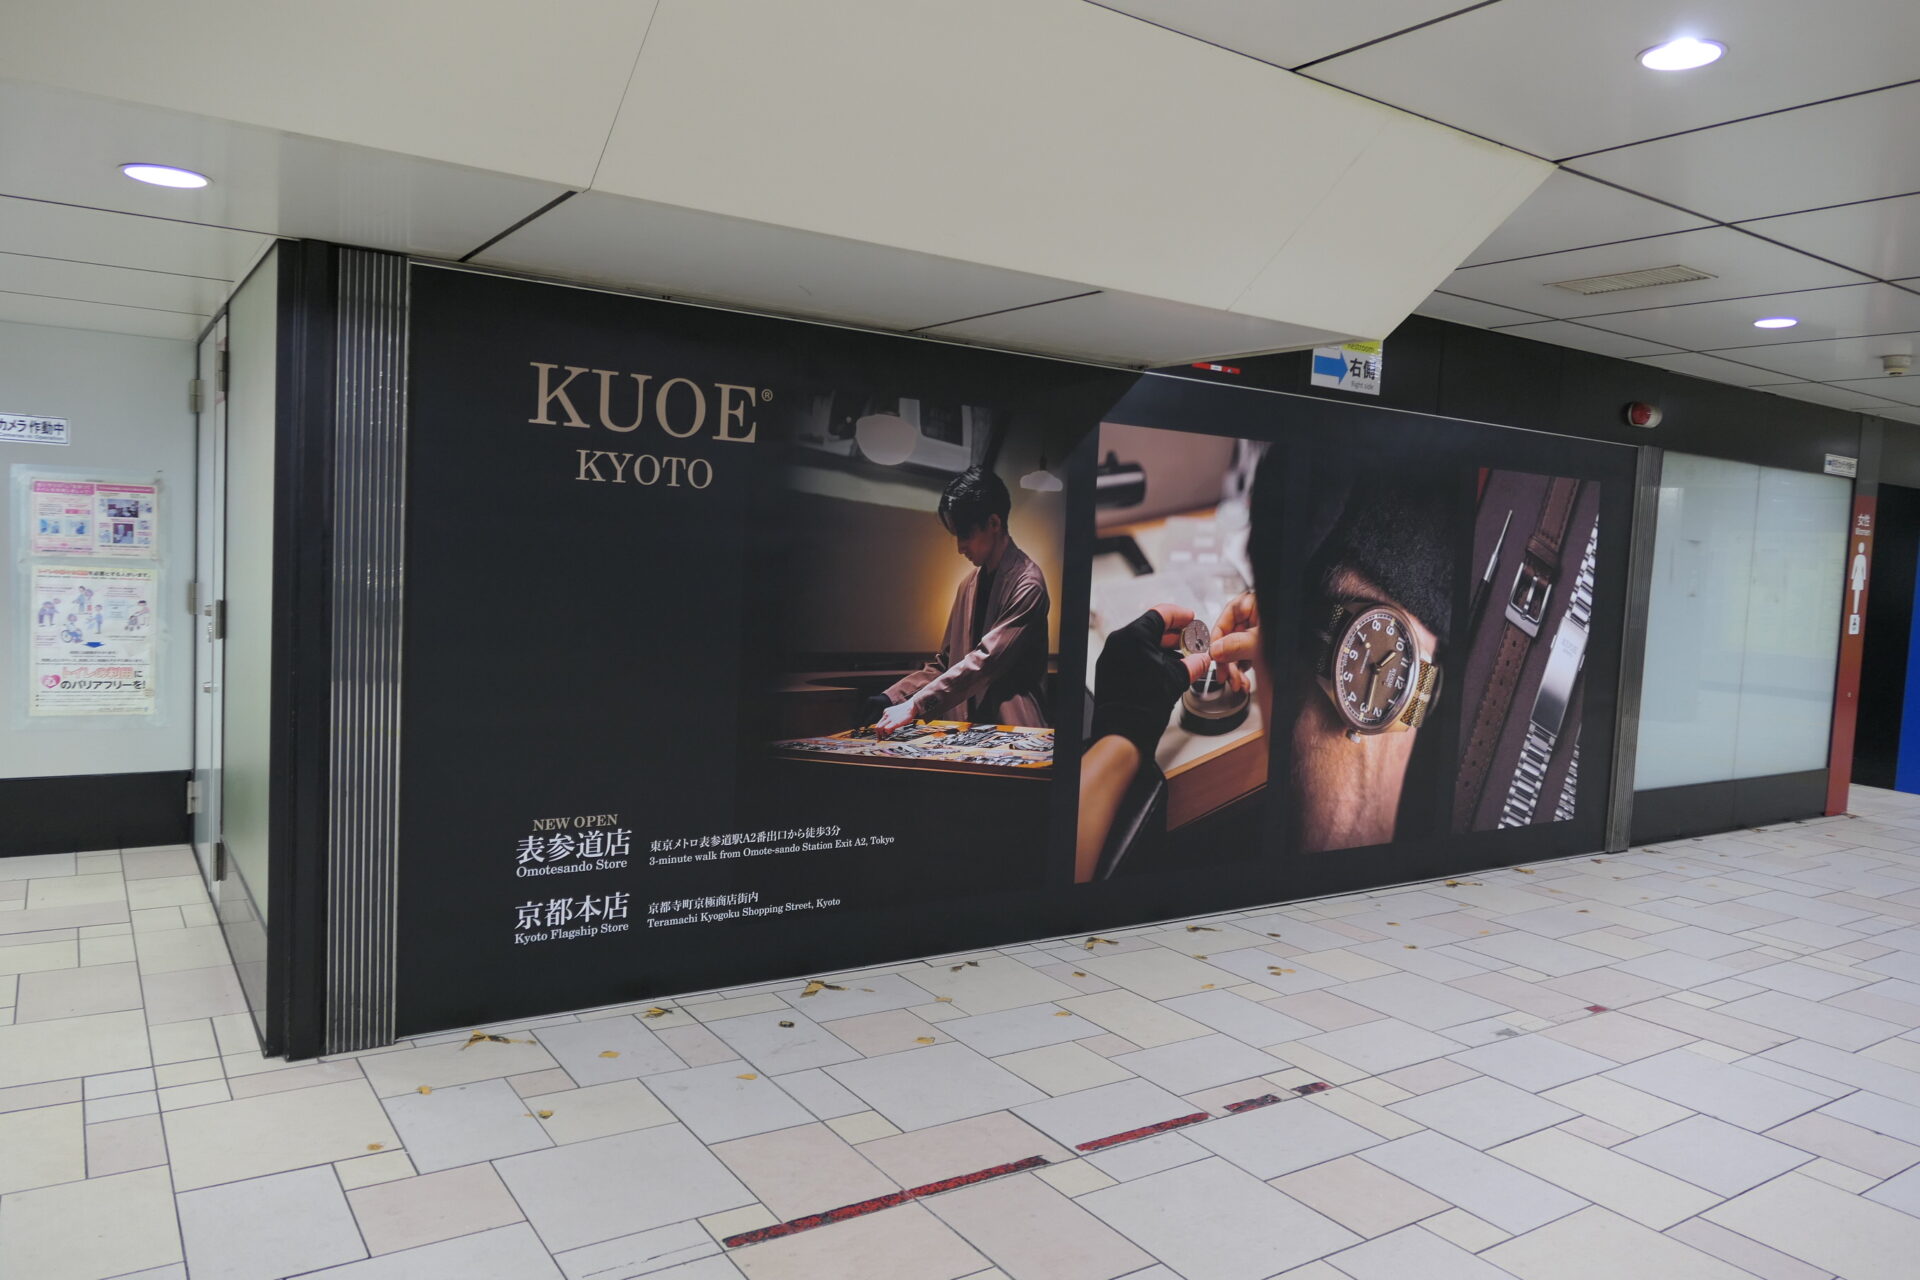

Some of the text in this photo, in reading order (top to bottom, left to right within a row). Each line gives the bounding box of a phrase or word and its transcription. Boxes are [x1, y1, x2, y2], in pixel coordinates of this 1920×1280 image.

[1349, 357, 1377, 380] 右側
[528, 361, 757, 443] KUOE
[575, 449, 713, 489] KYOTO
[1371, 620, 1381, 631] 8
[1386, 625, 1395, 636] 9
[1349, 649, 1359, 661] 6
[1343, 671, 1354, 683] 5
[1347, 691, 1357, 703] 4
[532, 814, 618, 831] NEW OPEN
[515, 828, 633, 864] 表参道店
[649, 835, 895, 866] 3-minute walk from Omote-sando Station Exit A2, Tokyo
[650, 825, 841, 853] 東京メトロ表参道駅A2番出口から徒歩3分
[516, 859, 628, 878] Omotesando Store
[514, 891, 630, 930] 京都本店
[647, 898, 841, 928] Teramachi Kyogoku Shopping Street, Kyoto
[648, 891, 759, 915] 京都寺町京極商店街内
[514, 922, 629, 946] Kyoto Flagship Store
